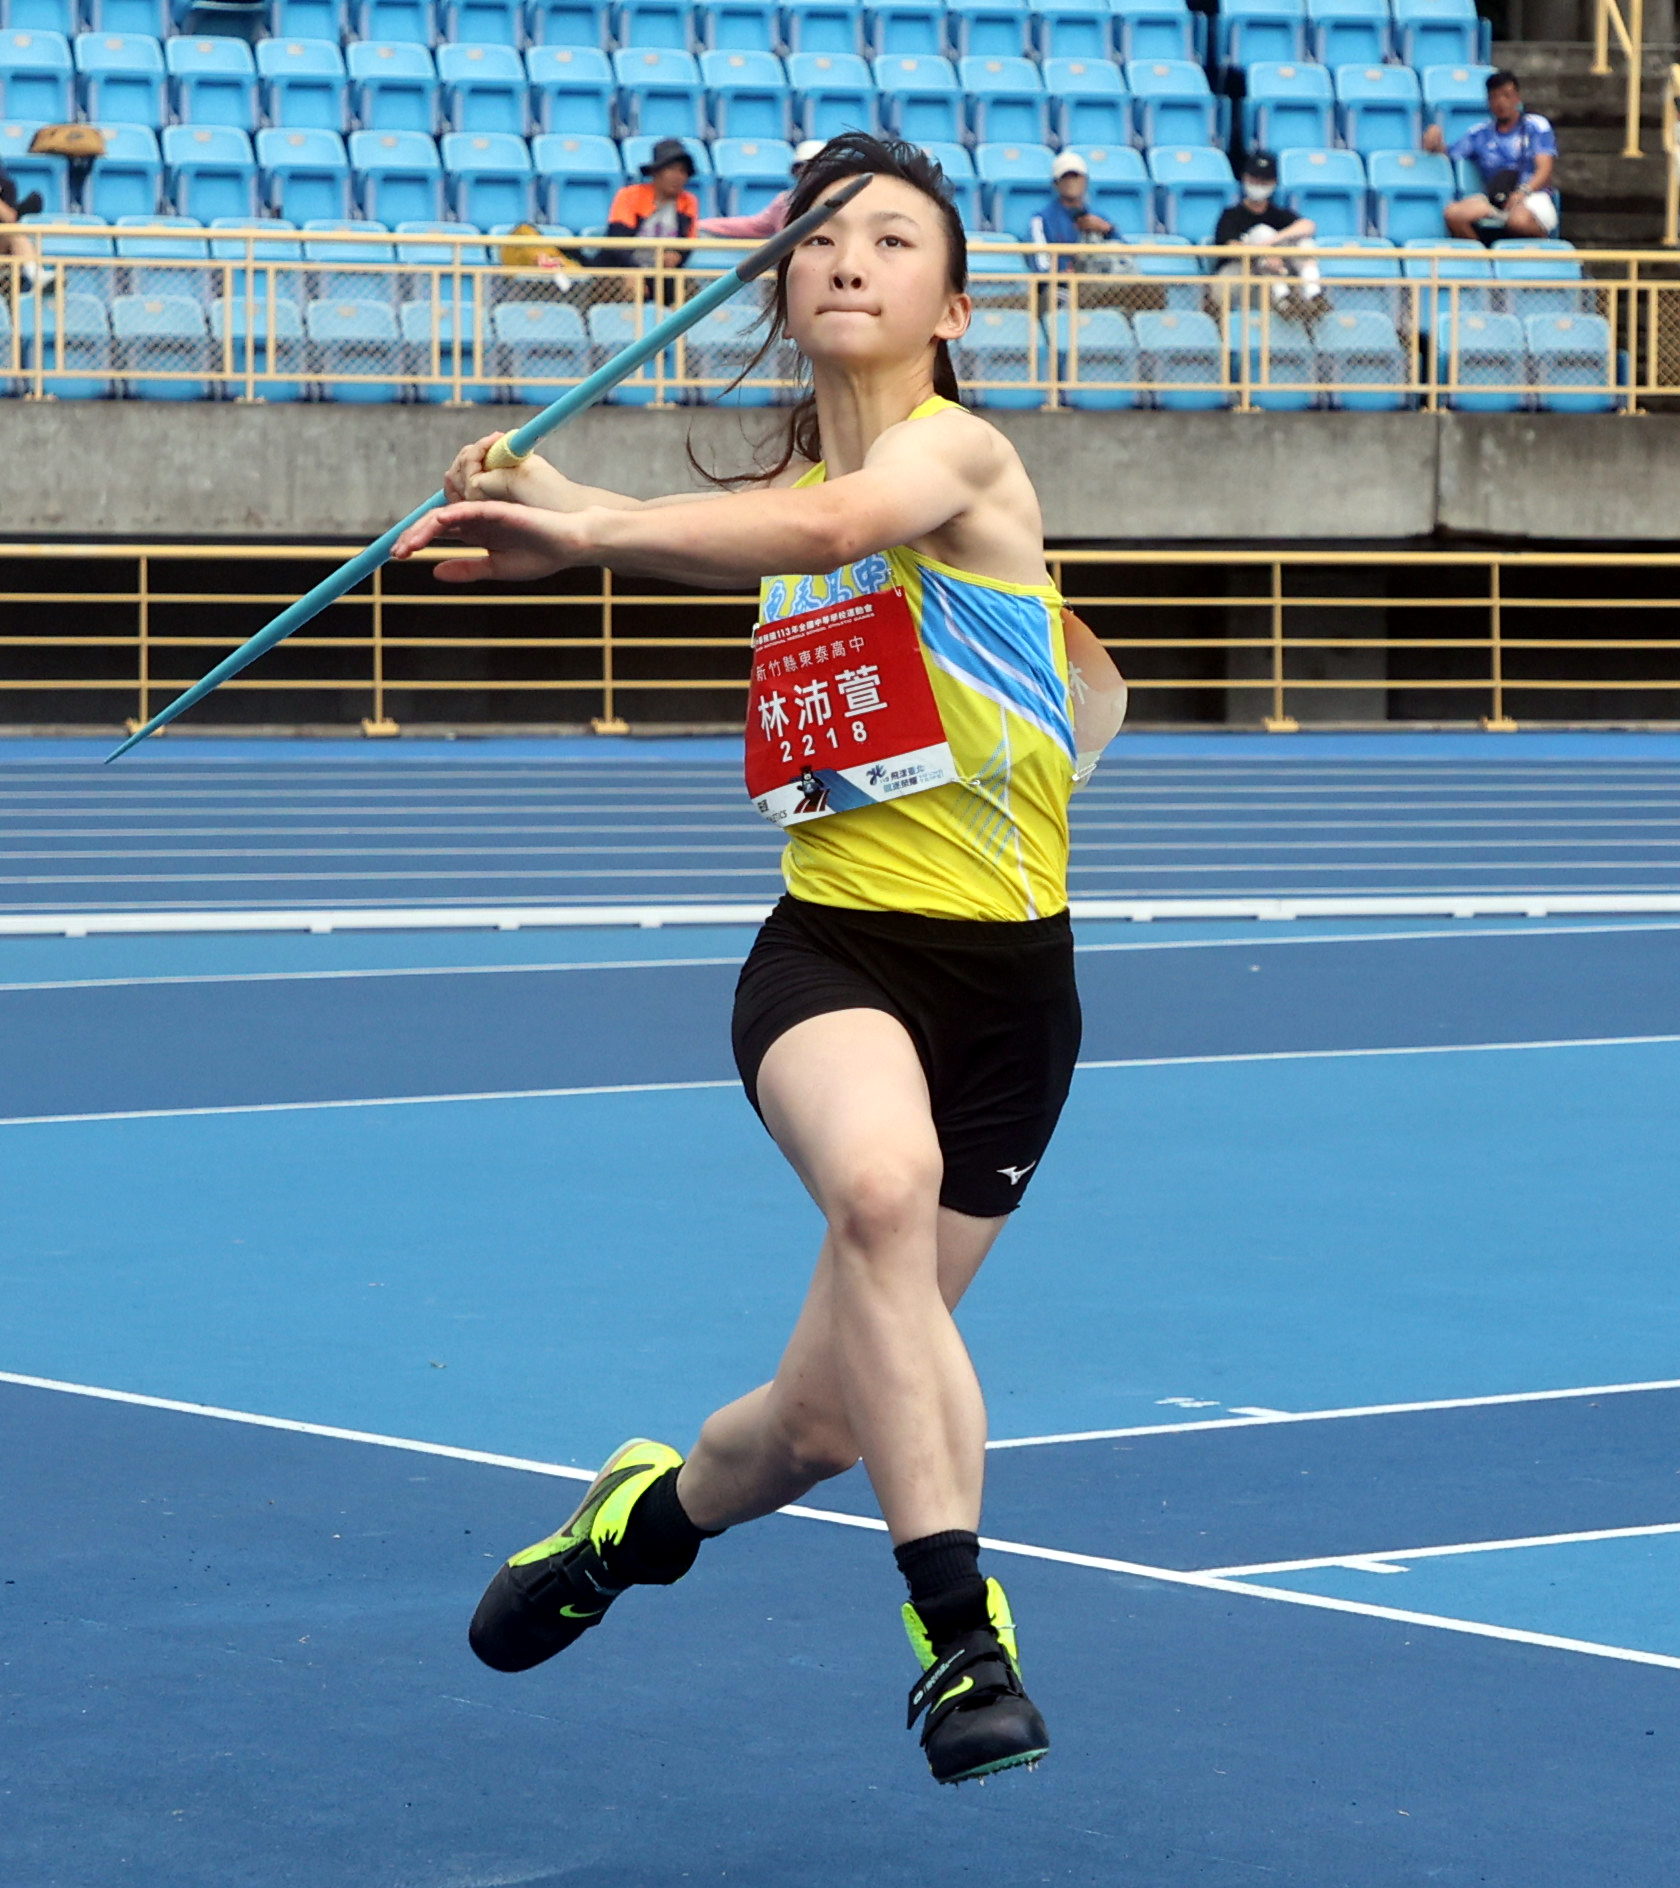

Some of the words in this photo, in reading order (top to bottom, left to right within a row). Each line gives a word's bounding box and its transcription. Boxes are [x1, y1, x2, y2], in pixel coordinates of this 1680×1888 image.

[756, 635, 865, 682] 新竹縣東泰高中
[757, 665, 888, 742] 林沛萱
[780, 721, 867, 763] 2218
